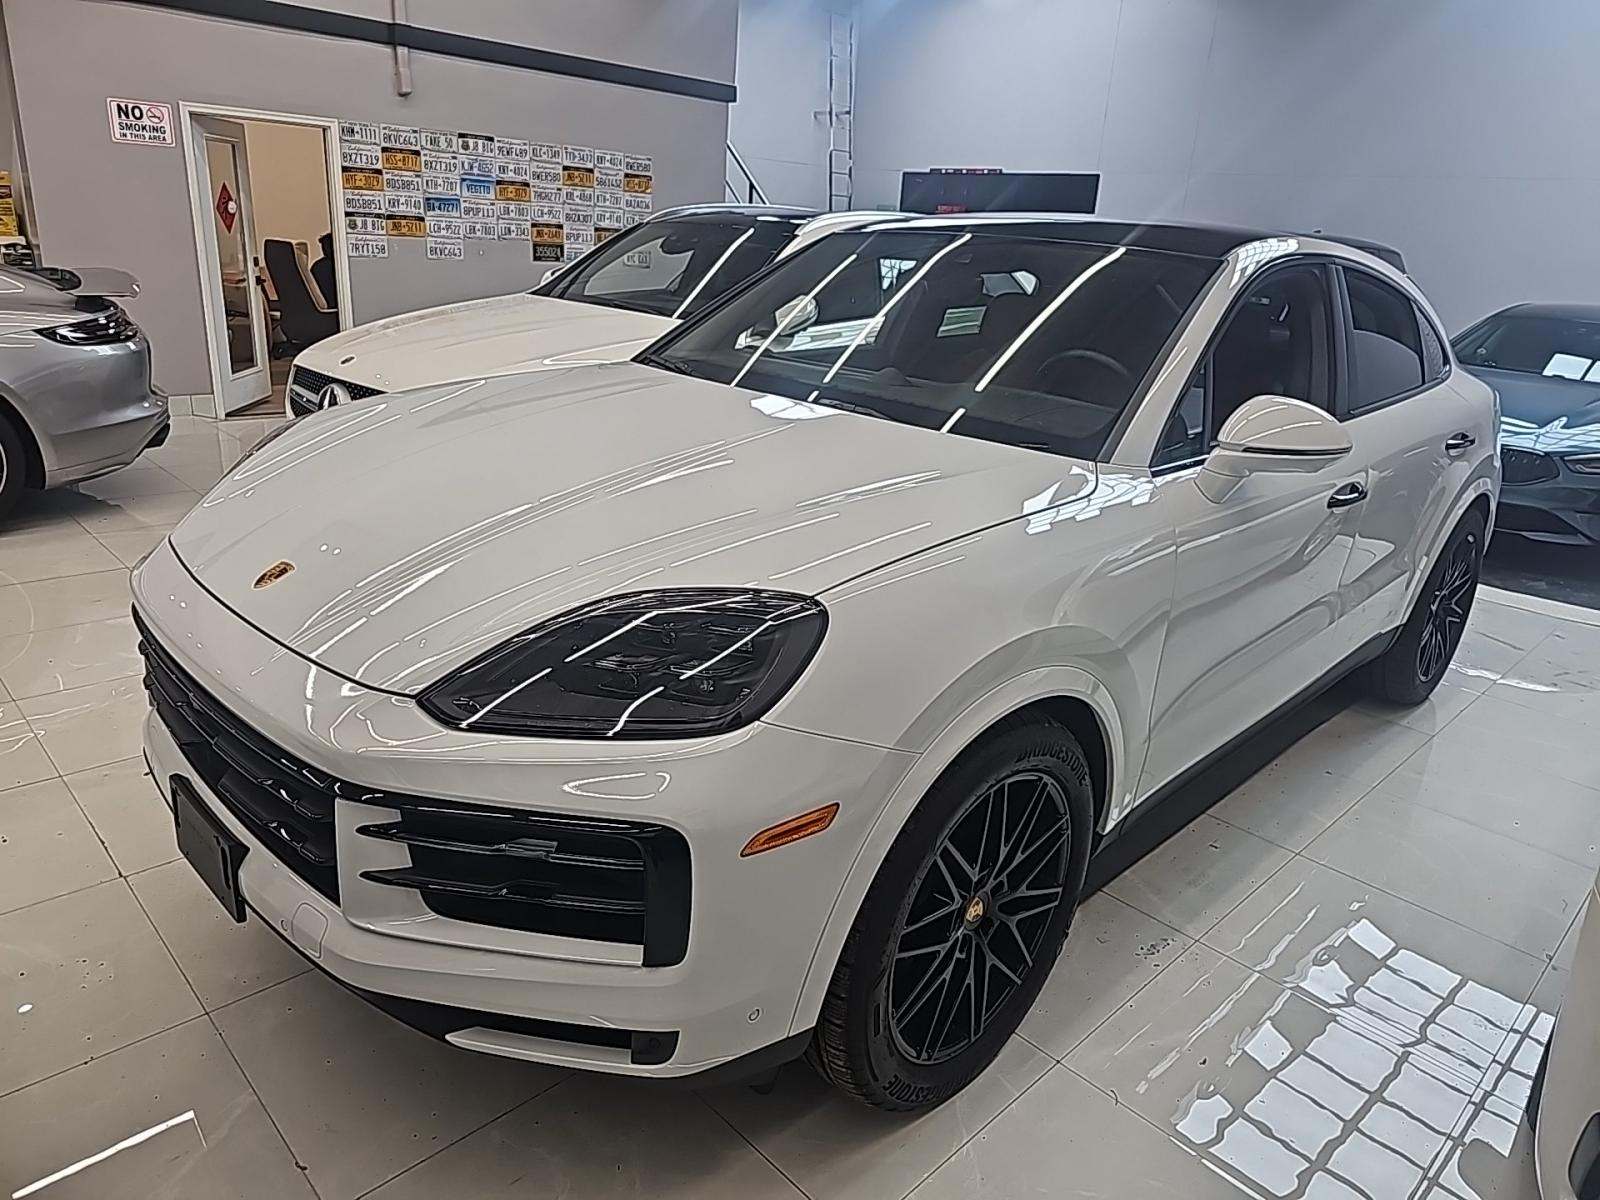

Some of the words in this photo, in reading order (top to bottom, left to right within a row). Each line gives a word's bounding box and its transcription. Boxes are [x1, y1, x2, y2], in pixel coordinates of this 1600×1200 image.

[116, 103, 144, 120] NO
[118, 122, 166, 134] SMOKING
[1014, 740, 1089, 787] BRIDGESTONE
